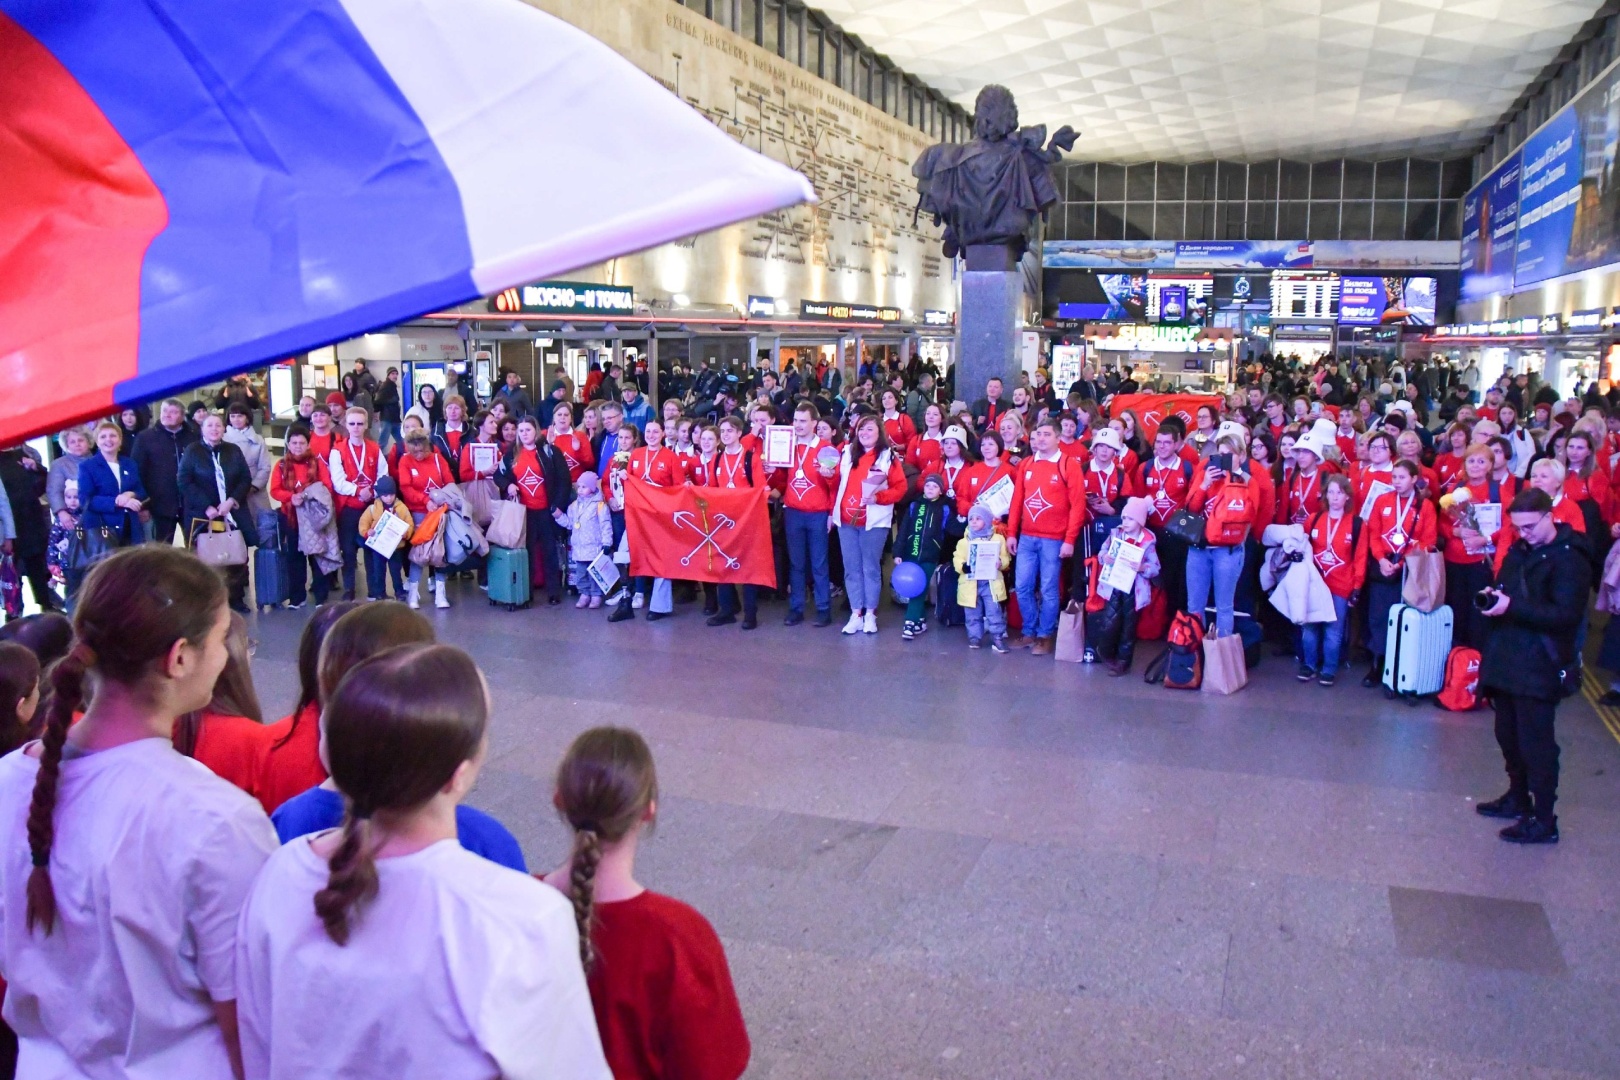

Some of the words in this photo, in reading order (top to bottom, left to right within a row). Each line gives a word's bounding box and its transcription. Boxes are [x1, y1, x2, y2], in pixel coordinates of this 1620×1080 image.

[1344, 279, 1373, 287] Билеты
[595, 290, 632, 309] ТОЧКА
[1118, 326, 1201, 342] SUBWAY
